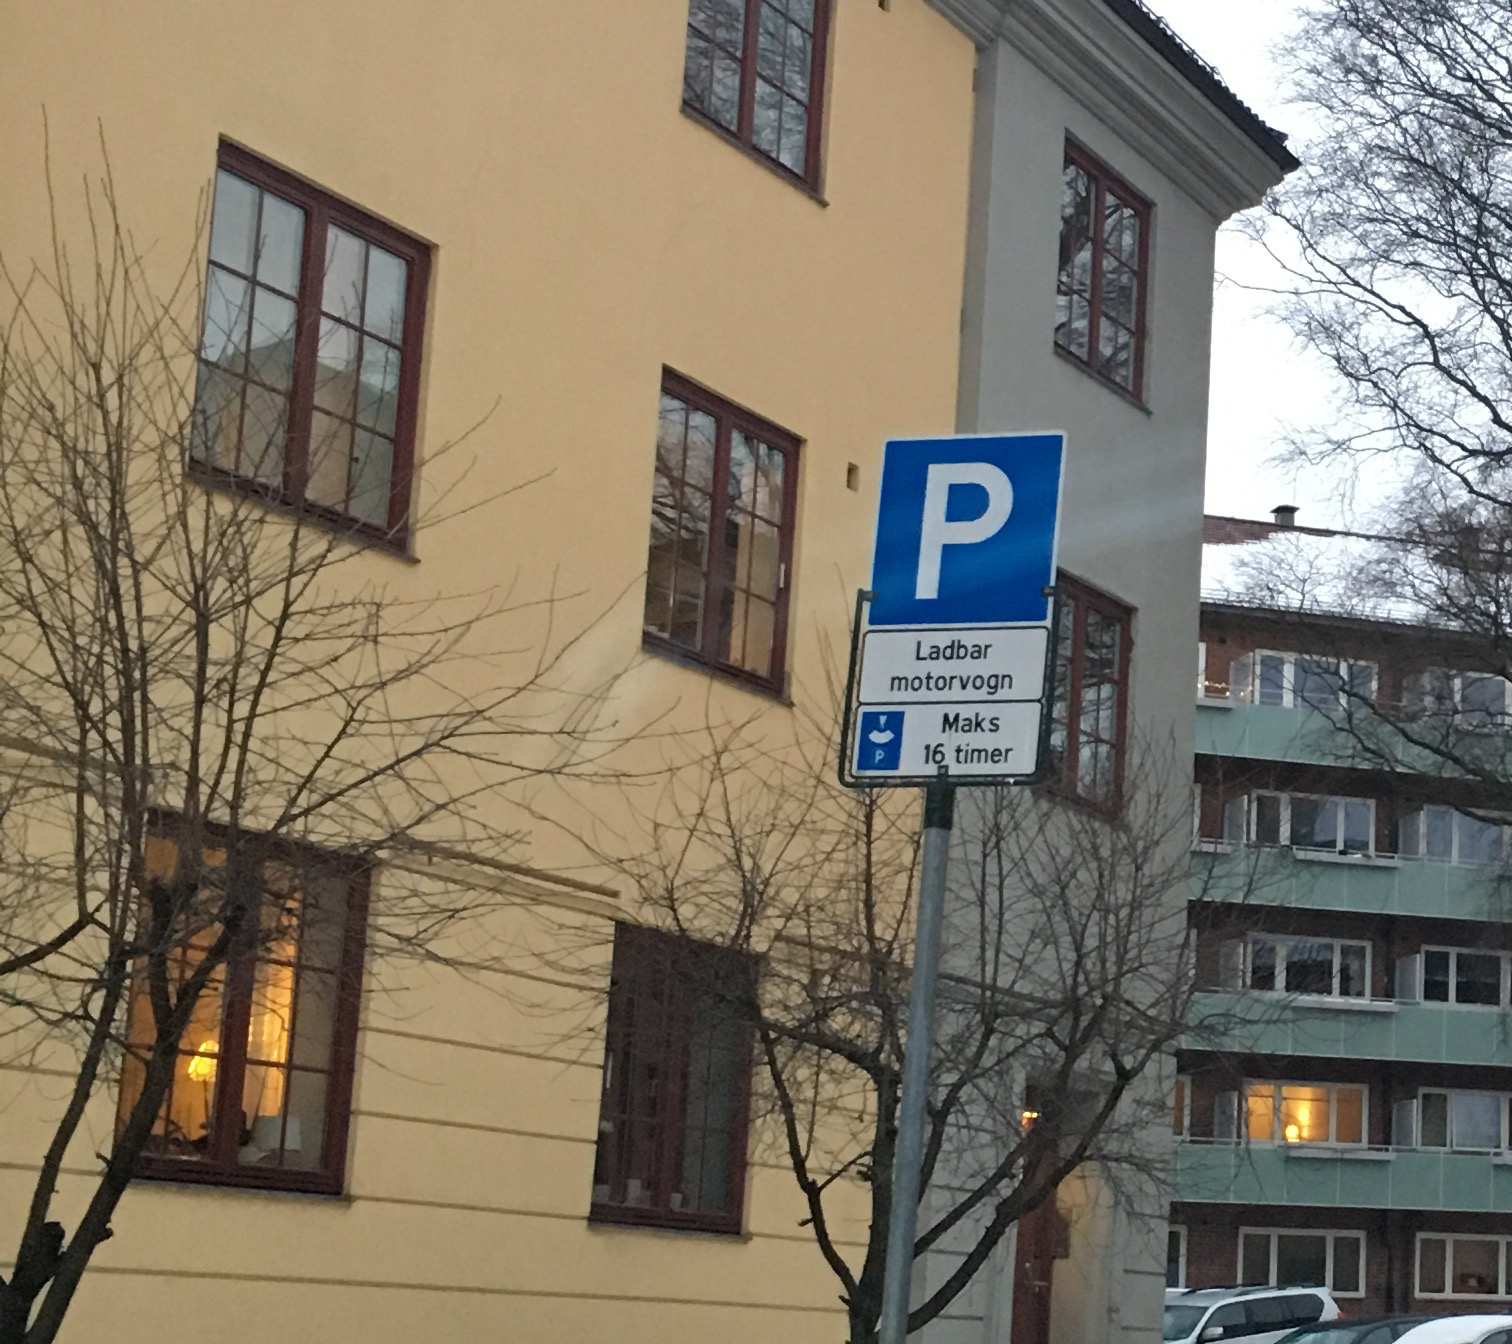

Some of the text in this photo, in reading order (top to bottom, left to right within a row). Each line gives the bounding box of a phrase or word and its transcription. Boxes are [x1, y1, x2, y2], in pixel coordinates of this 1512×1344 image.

[915, 462, 1014, 600] P
[915, 639, 993, 661] Ladbar
[890, 671, 1013, 695] motorvogn
[941, 712, 1001, 733] Maks
[874, 749, 885, 764] P
[924, 742, 1013, 765] 16 timer
